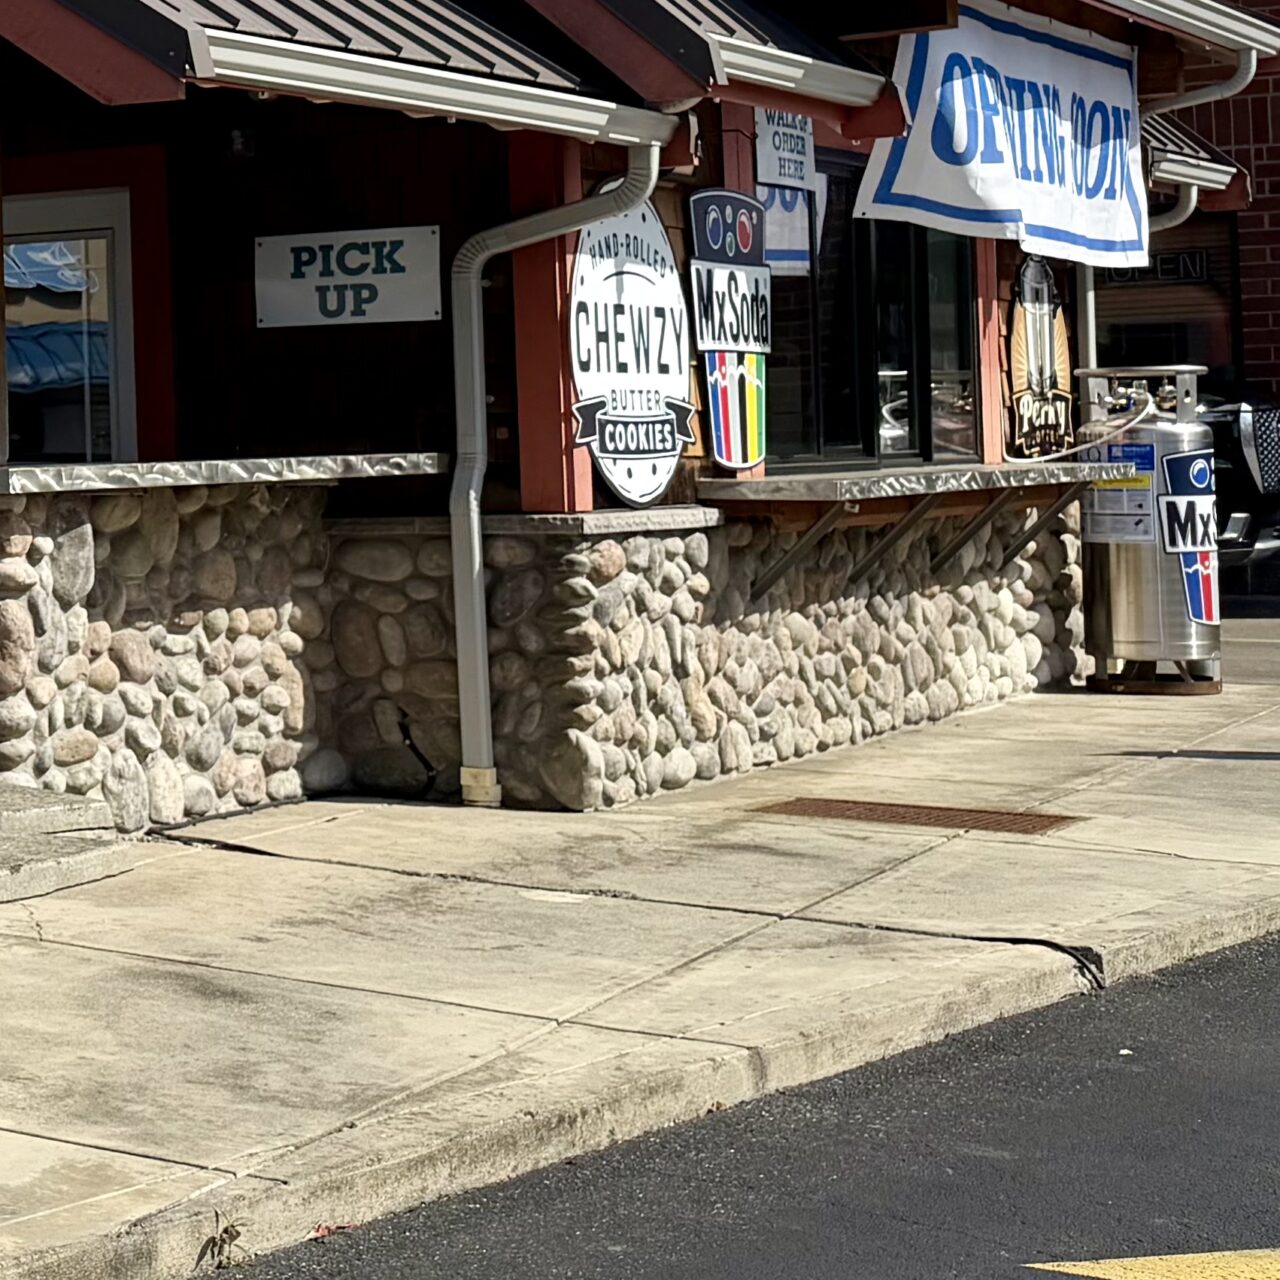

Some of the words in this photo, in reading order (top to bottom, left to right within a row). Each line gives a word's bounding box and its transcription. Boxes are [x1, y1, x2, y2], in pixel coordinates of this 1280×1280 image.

[773, 131, 806, 157] ORDER
[931, 52, 1066, 188] OPNING
[1072, 91, 1131, 200] OON
[778, 157, 805, 181] HERE
[290, 240, 406, 279] PICK
[589, 232, 667, 278] HAND-ROLLED
[315, 283, 379, 318] UP
[695, 267, 769, 345] MxSoda
[575, 301, 683, 375] CHEWZY
[611, 389, 662, 412] BUTTER
[605, 423, 673, 452] COOKIES
[1165, 500, 1218, 548] Mx
